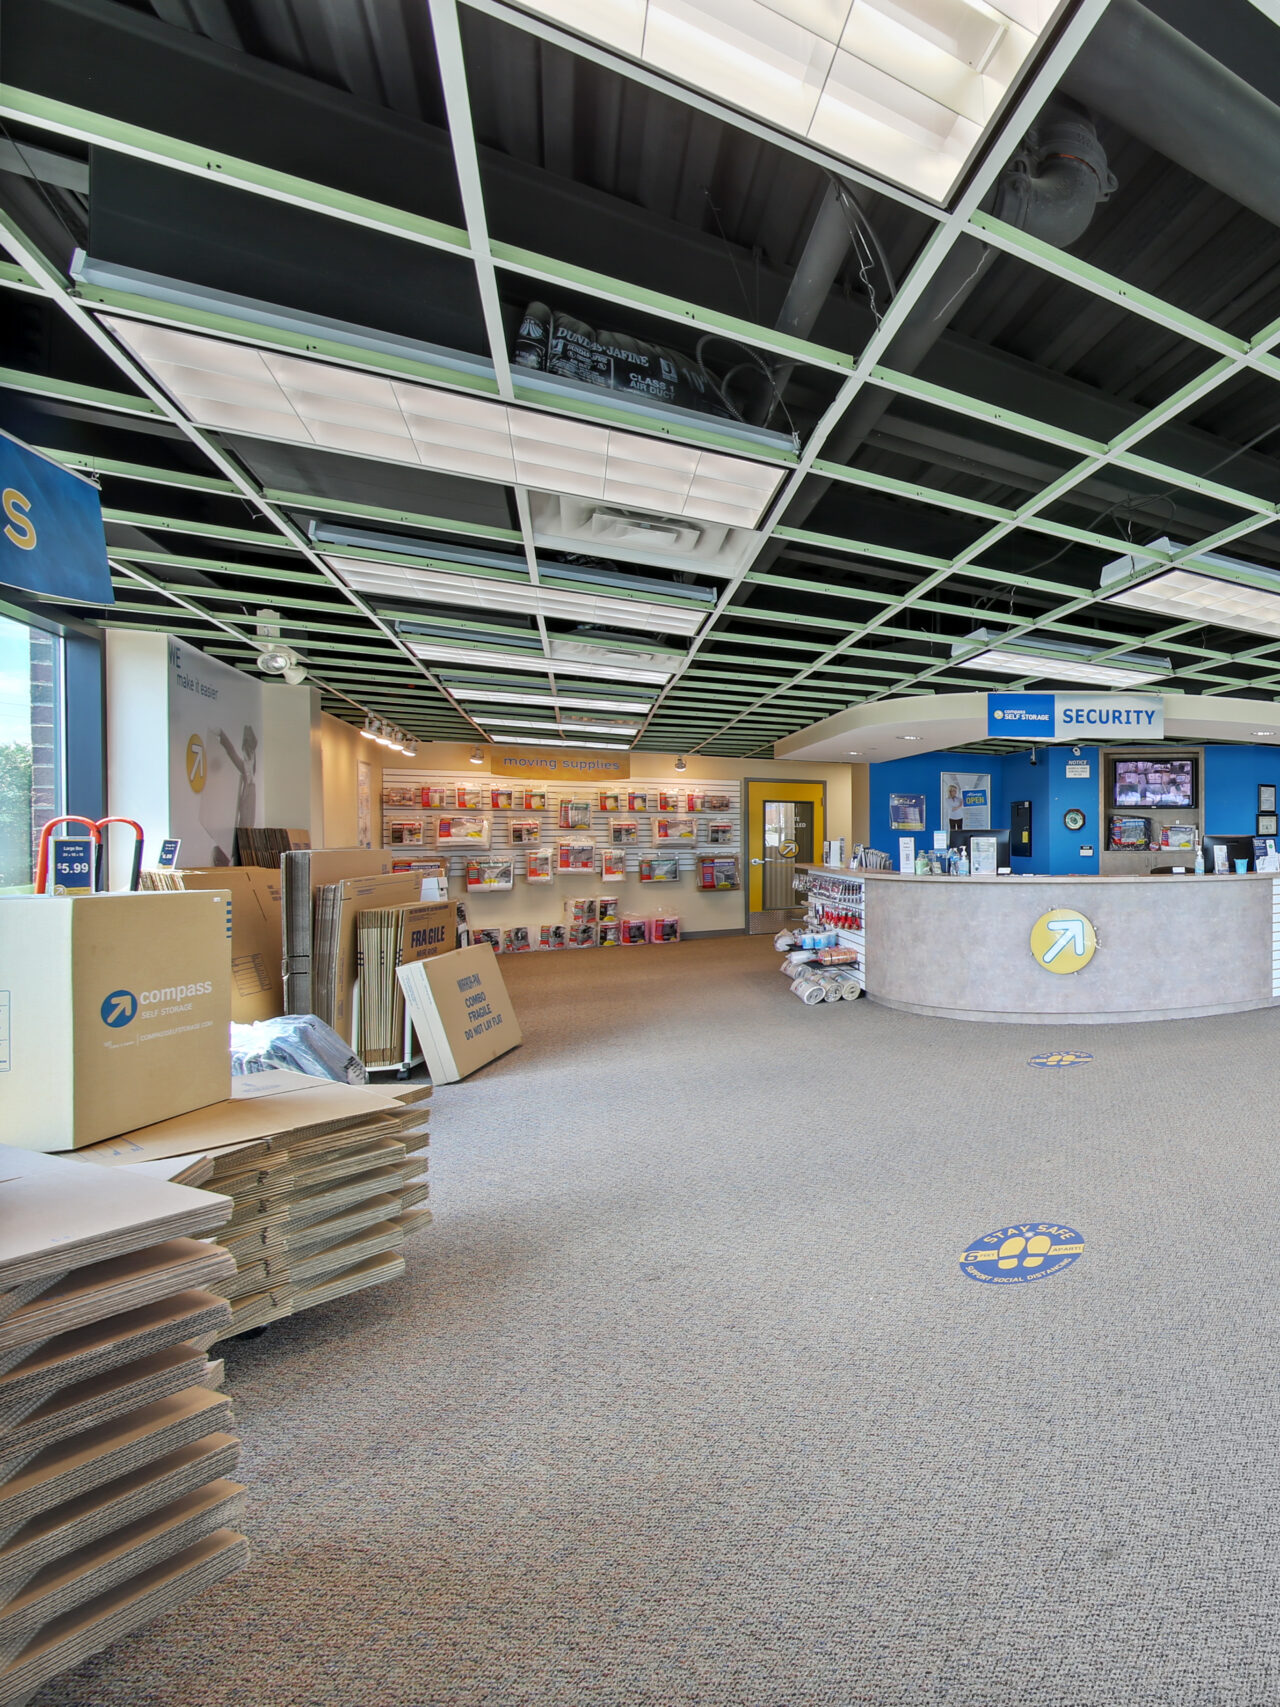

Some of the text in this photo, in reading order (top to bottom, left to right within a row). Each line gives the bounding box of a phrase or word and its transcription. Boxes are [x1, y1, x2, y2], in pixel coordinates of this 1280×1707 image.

[629, 372, 666, 390] CLASS
[630, 380, 675, 399] AIR DUCT
[176, 673, 194, 692] make
[201, 684, 219, 700] easier
[1062, 708, 1156, 725] SECURITY
[503, 757, 620, 771] moving supplies
[966, 796, 985, 805] OPEN
[57, 862, 89, 874] $5.99
[411, 926, 446, 948] FRAGILE
[140, 981, 213, 1005] compass
[465, 992, 486, 1008] COMBO
[141, 1003, 193, 1019] SELF STORAGE
[468, 1004, 492, 1023] FRAGILE
[464, 1014, 503, 1040] DO NOT LAY FLAT
[983, 1224, 1076, 1244] STAY SAFE
[964, 1250, 983, 1263] 6
[965, 1265, 994, 1281] SUPPORT
[1027, 1257, 1073, 1280] DISTANCING
